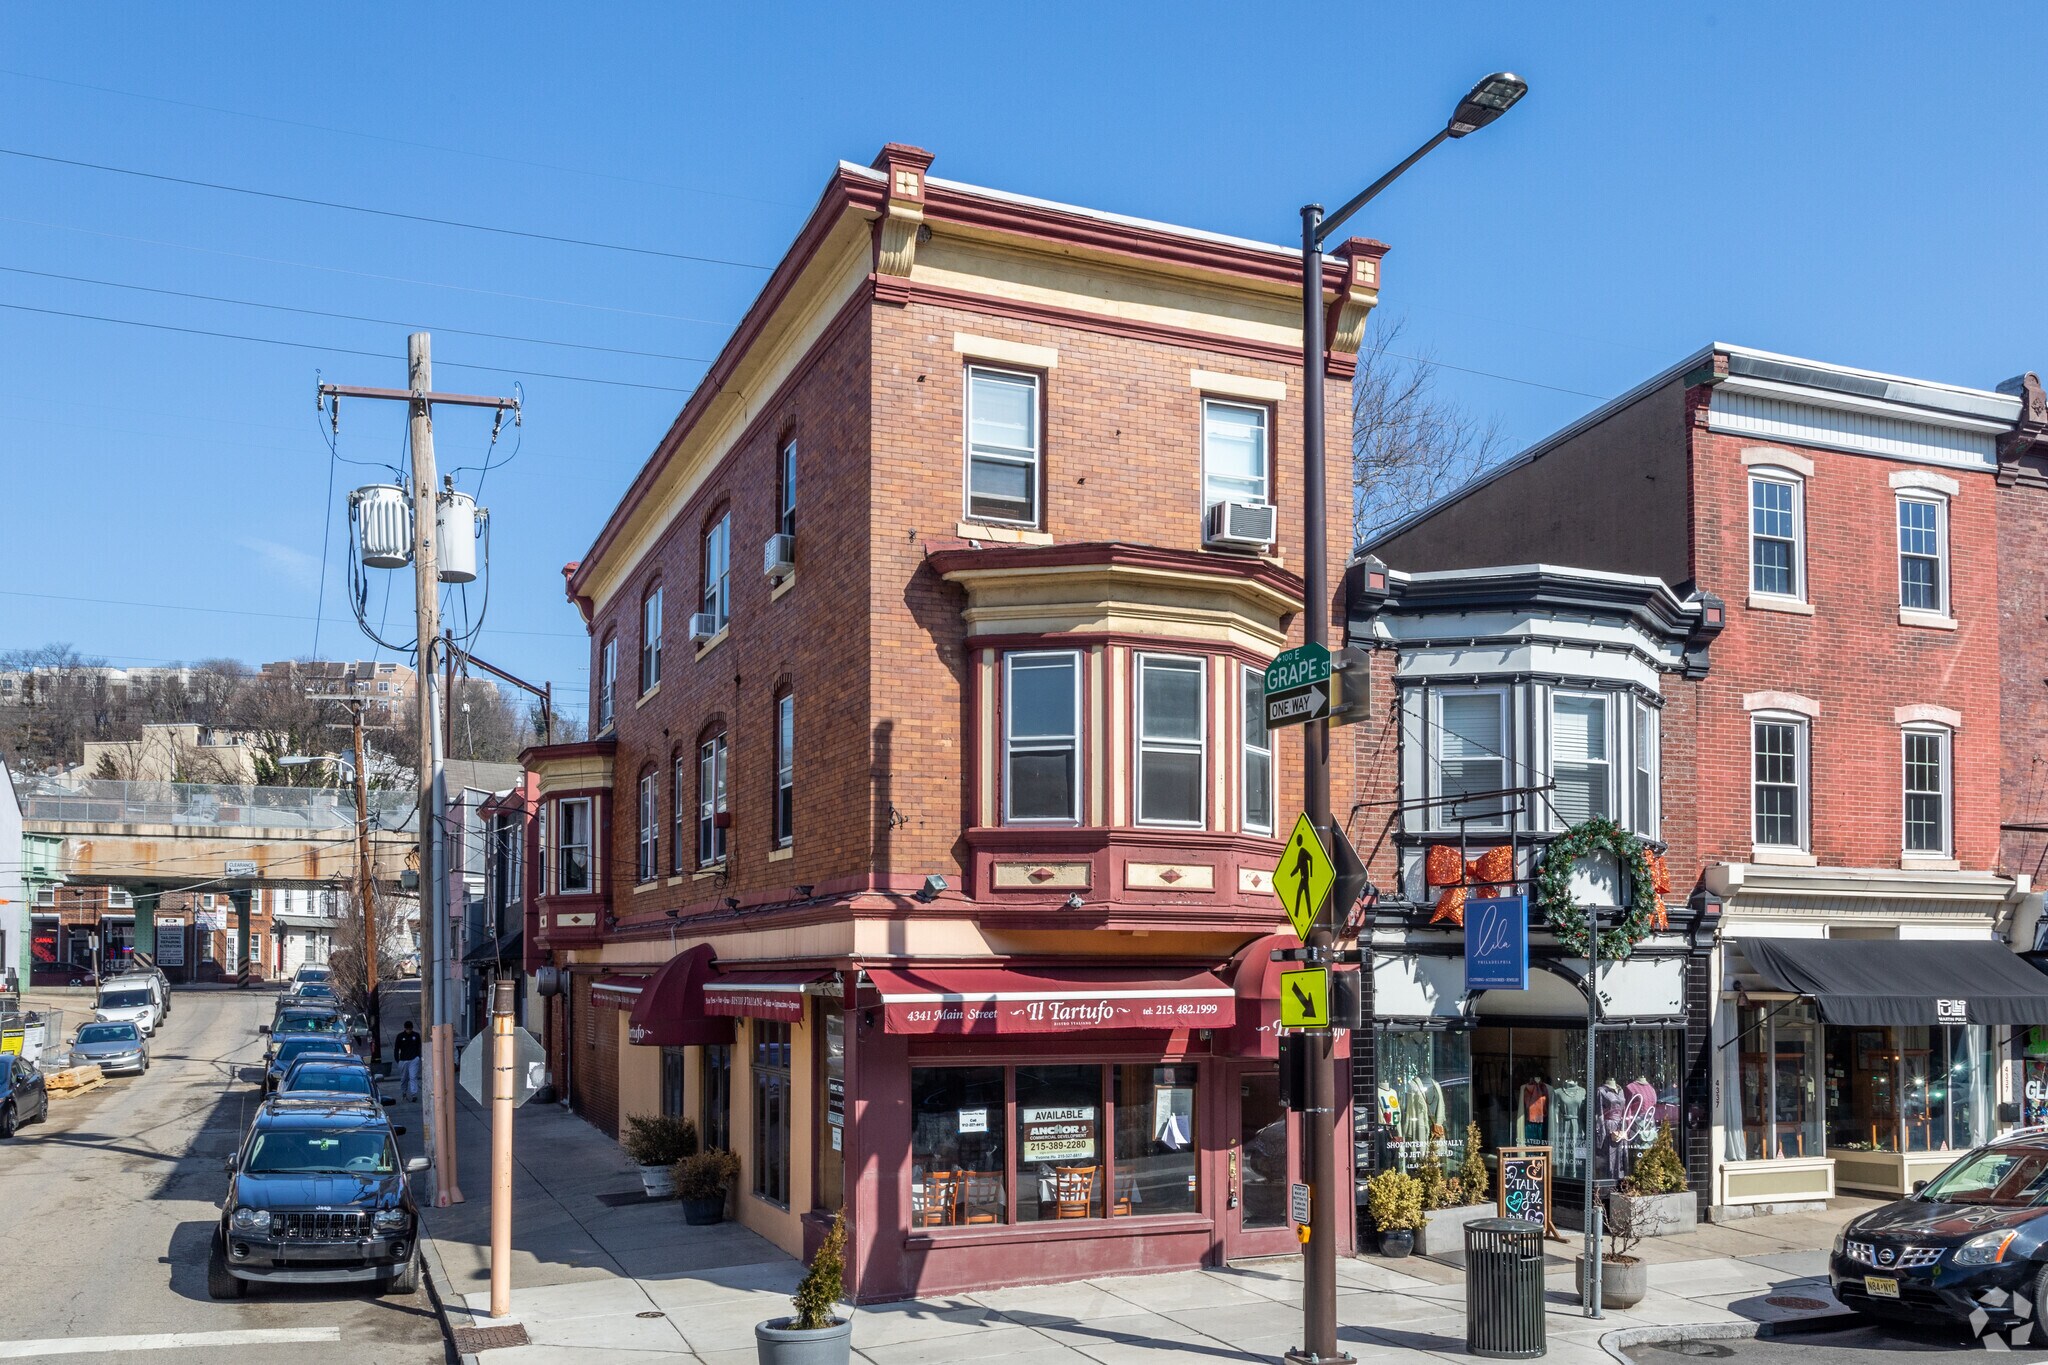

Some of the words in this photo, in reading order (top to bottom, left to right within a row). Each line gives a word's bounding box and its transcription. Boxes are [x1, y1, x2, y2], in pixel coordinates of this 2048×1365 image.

[1282, 653, 1293, 662] 100
[1294, 649, 1300, 660] E
[1267, 658, 1317, 690] GRAPE
[1321, 661, 1330, 676] ST
[1272, 701, 1289, 718] ONE
[1292, 695, 1310, 713] WAY
[907, 1010, 931, 1021] 4341
[933, 1009, 963, 1021] Main
[967, 1008, 998, 1020] Street
[1026, 1001, 1044, 1021] Il
[1049, 1000, 1114, 1025] Tartufo
[1143, 1007, 1153, 1015] tel:
[1034, 1110, 1083, 1120] AVAILABLE
[1030, 1124, 1080, 1136] ANCHOR
[1030, 1140, 1086, 1151] 215-389-2280
[1398, 1151, 1408, 1159] NO
[1515, 1179, 1539, 1190] TALK
